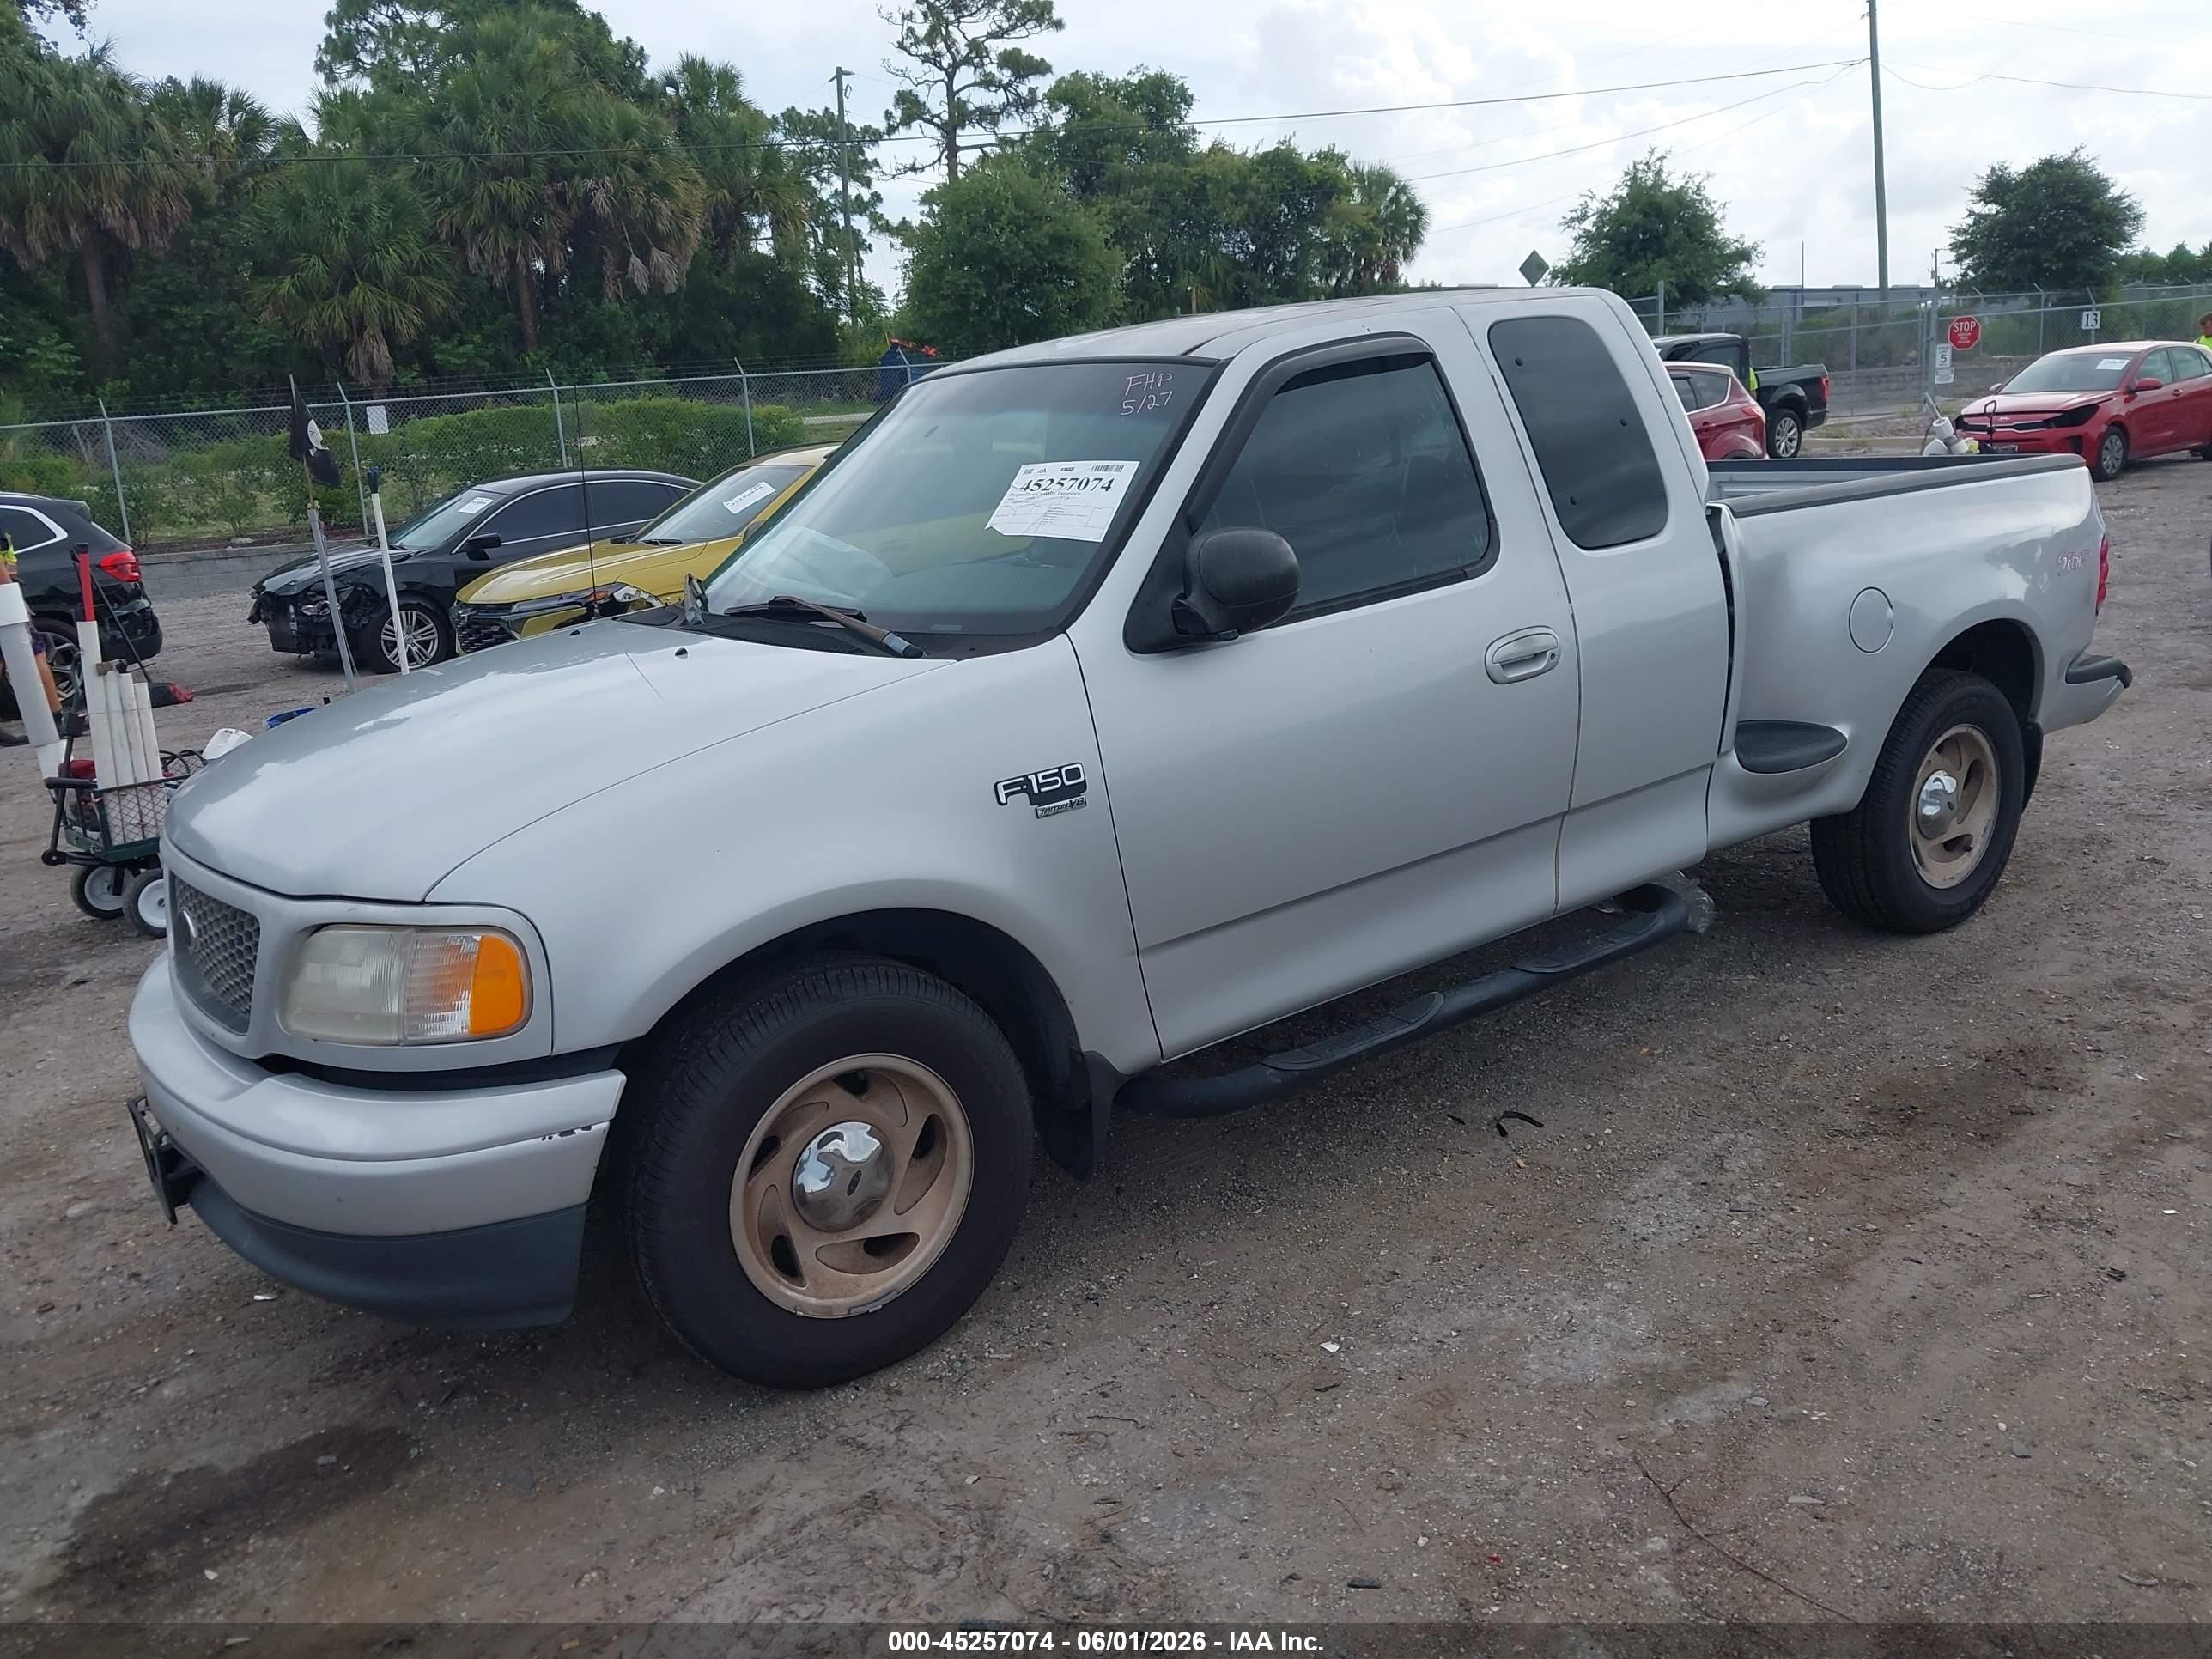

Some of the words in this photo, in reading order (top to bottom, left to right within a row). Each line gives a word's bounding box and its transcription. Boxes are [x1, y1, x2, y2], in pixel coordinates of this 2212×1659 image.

[1953, 321, 1977, 332] STOP
[2086, 313, 2098, 327] 13
[1941, 354, 1948, 362] 5
[1126, 371, 1173, 395] FHP
[1121, 391, 1173, 416] 5/27
[1020, 477, 1115, 492] 45257074
